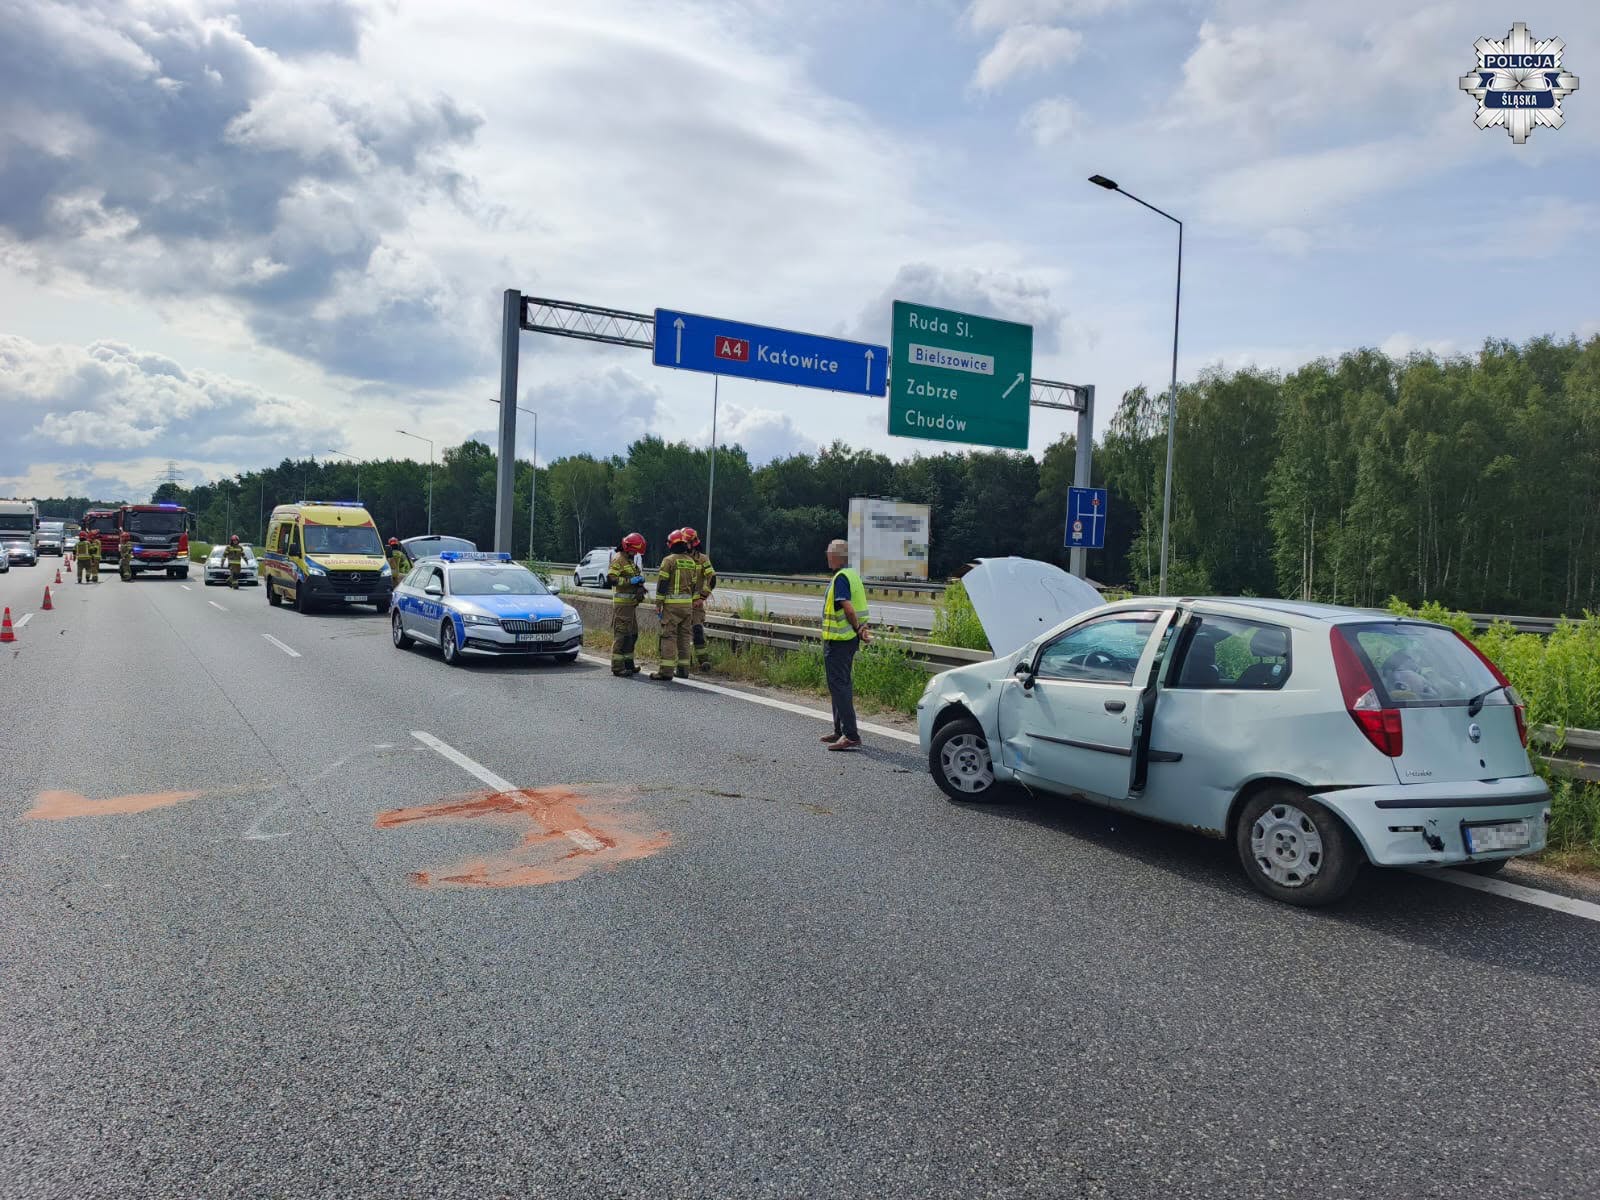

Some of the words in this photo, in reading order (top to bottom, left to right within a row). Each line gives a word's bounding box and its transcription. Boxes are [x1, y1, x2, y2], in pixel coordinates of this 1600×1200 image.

[909, 312, 948, 333] Ruda
[956, 317, 974, 338] Śl.
[721, 341, 742, 357] A4
[757, 344, 839, 373] Katowice
[916, 348, 987, 371] Bielszowice
[907, 378, 958, 400] Zabrze
[905, 410, 967, 431] Chudów
